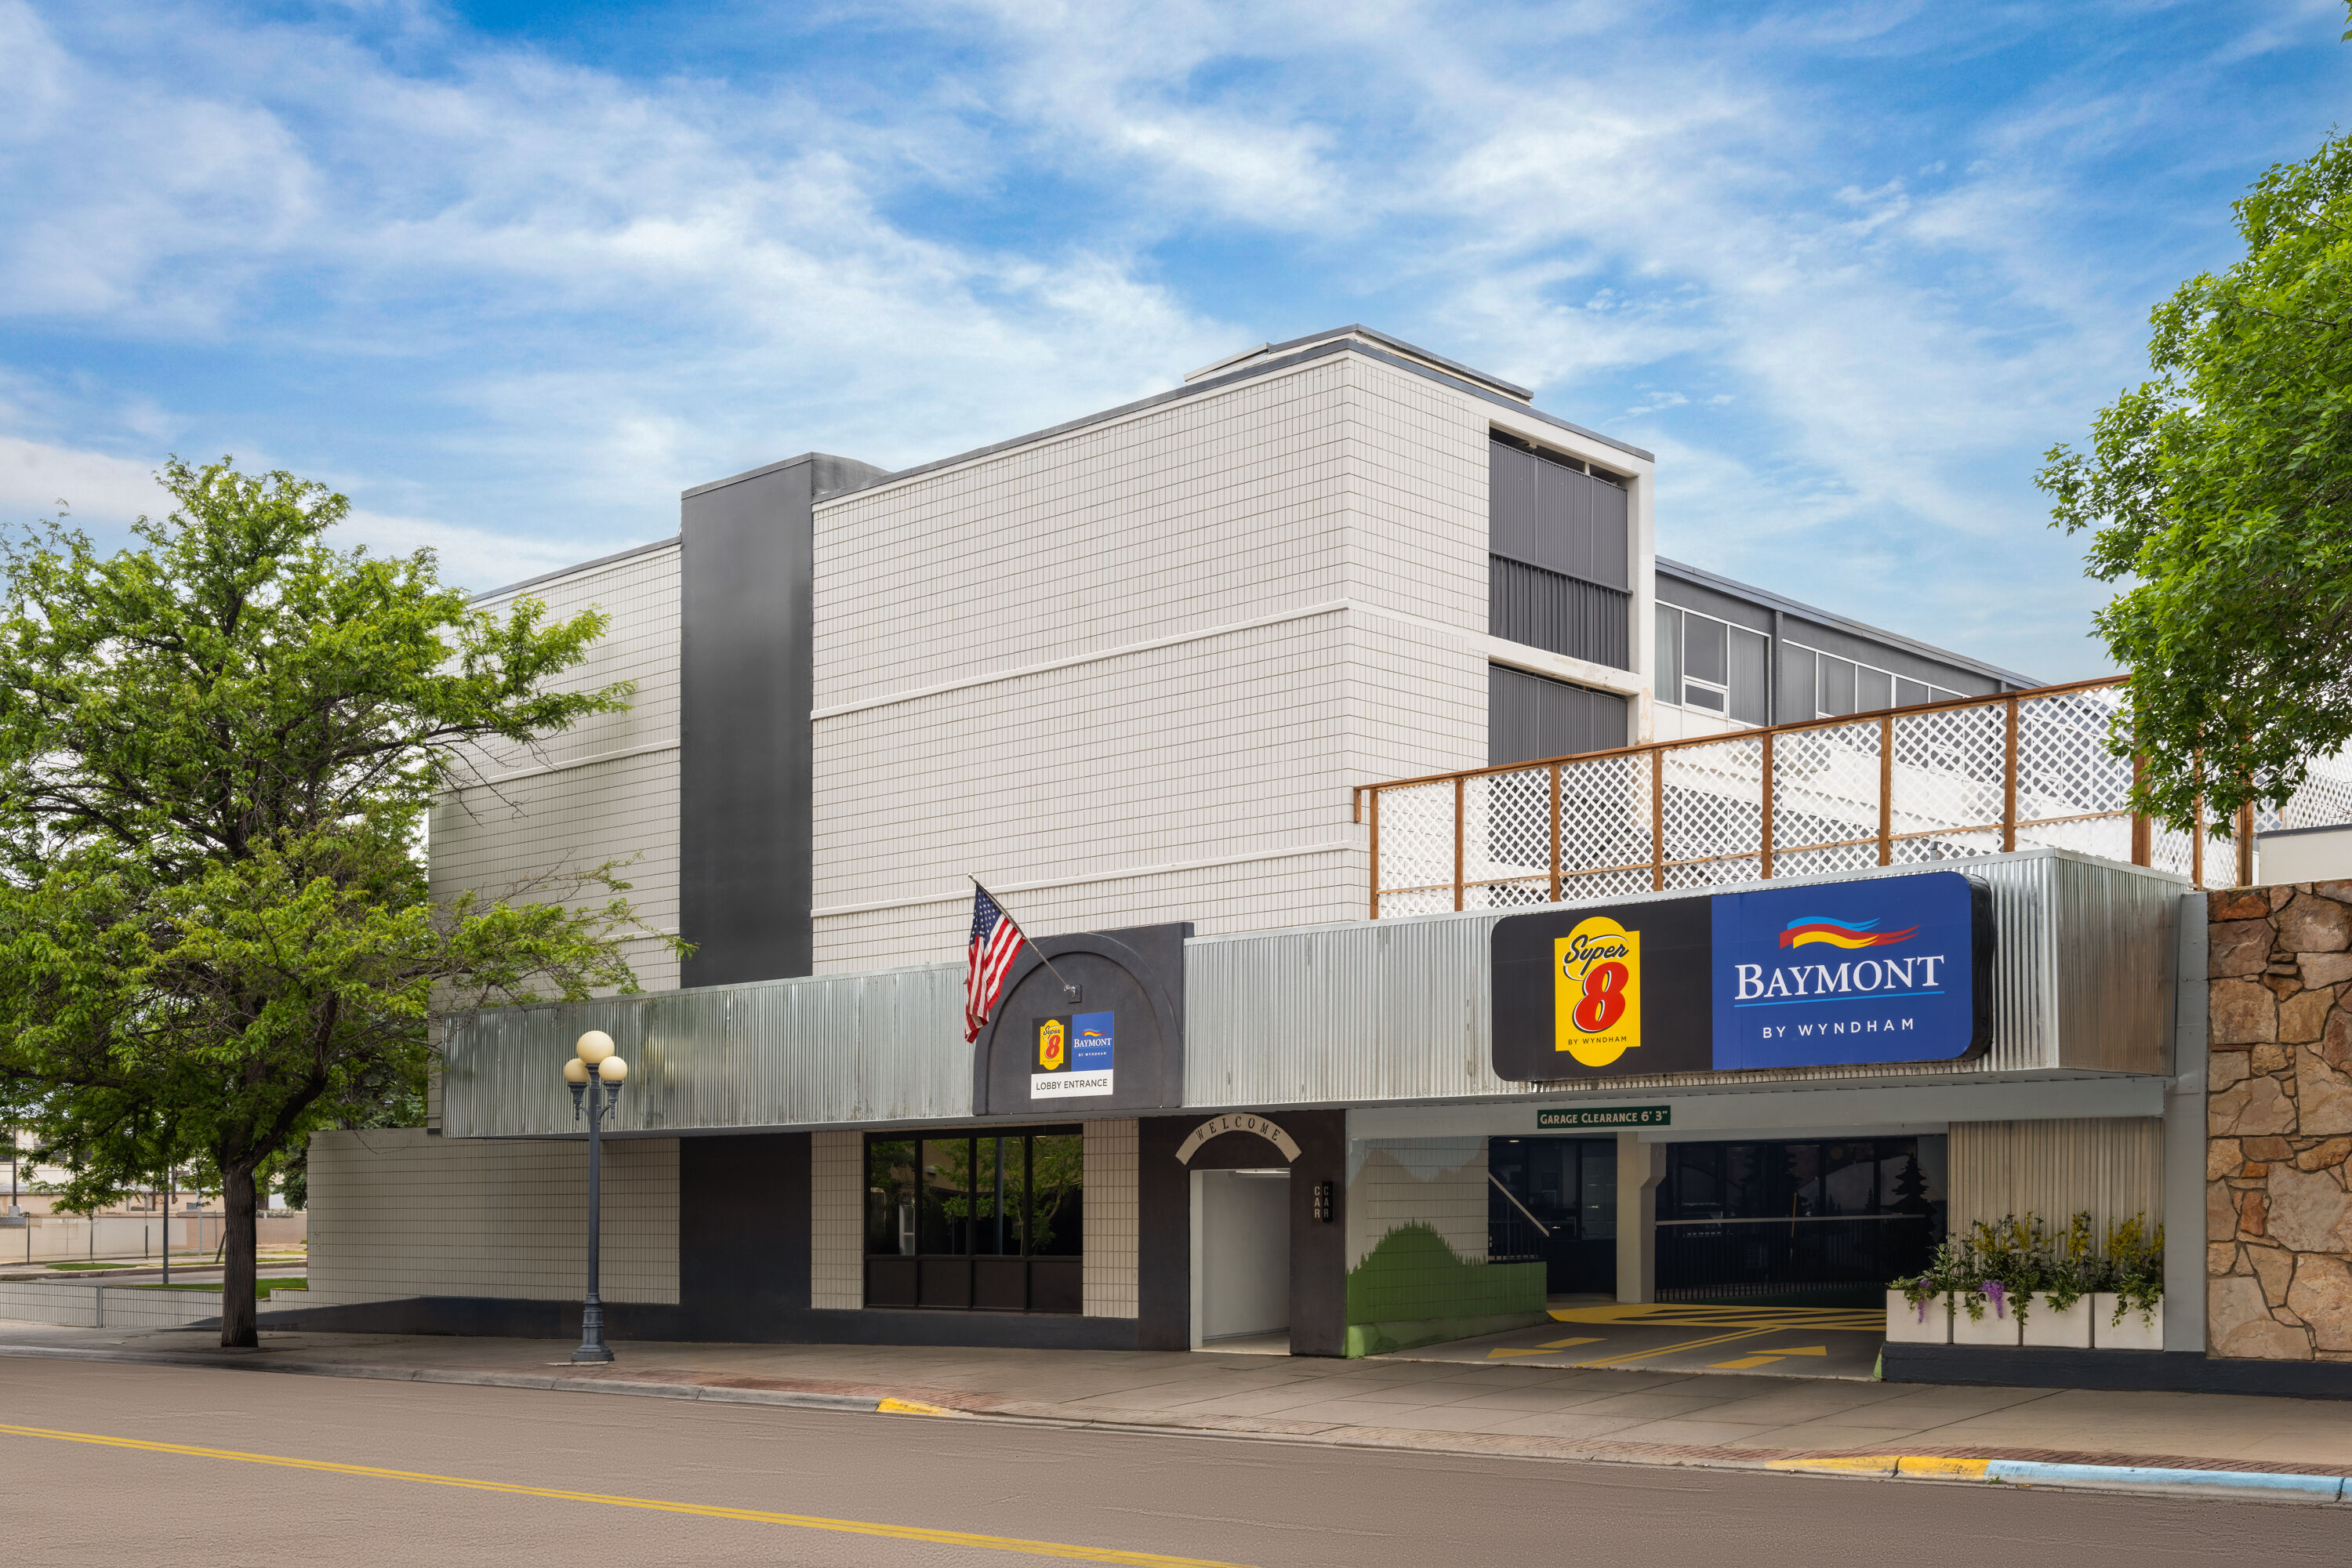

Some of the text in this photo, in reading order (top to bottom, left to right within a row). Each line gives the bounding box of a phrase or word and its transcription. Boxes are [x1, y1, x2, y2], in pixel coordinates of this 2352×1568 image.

[1563, 935, 1629, 978] Super
[1734, 954, 1945, 1000] BAYMONT
[1572, 961, 1629, 1034] 8
[1044, 1025, 1060, 1040] Super
[1762, 1018, 1914, 1039] BY WYNDHAM
[1044, 1035, 1061, 1059] 8
[1073, 1038, 1112, 1047] BAYMONT
[1582, 1036, 1628, 1044] WYNDHAM
[1036, 1078, 1108, 1091] LOBBY ENTRANCE
[1540, 1110, 1668, 1125] GARAGE CLEARANCE 6' 3"
[1196, 1116, 1279, 1142] WELCOME
